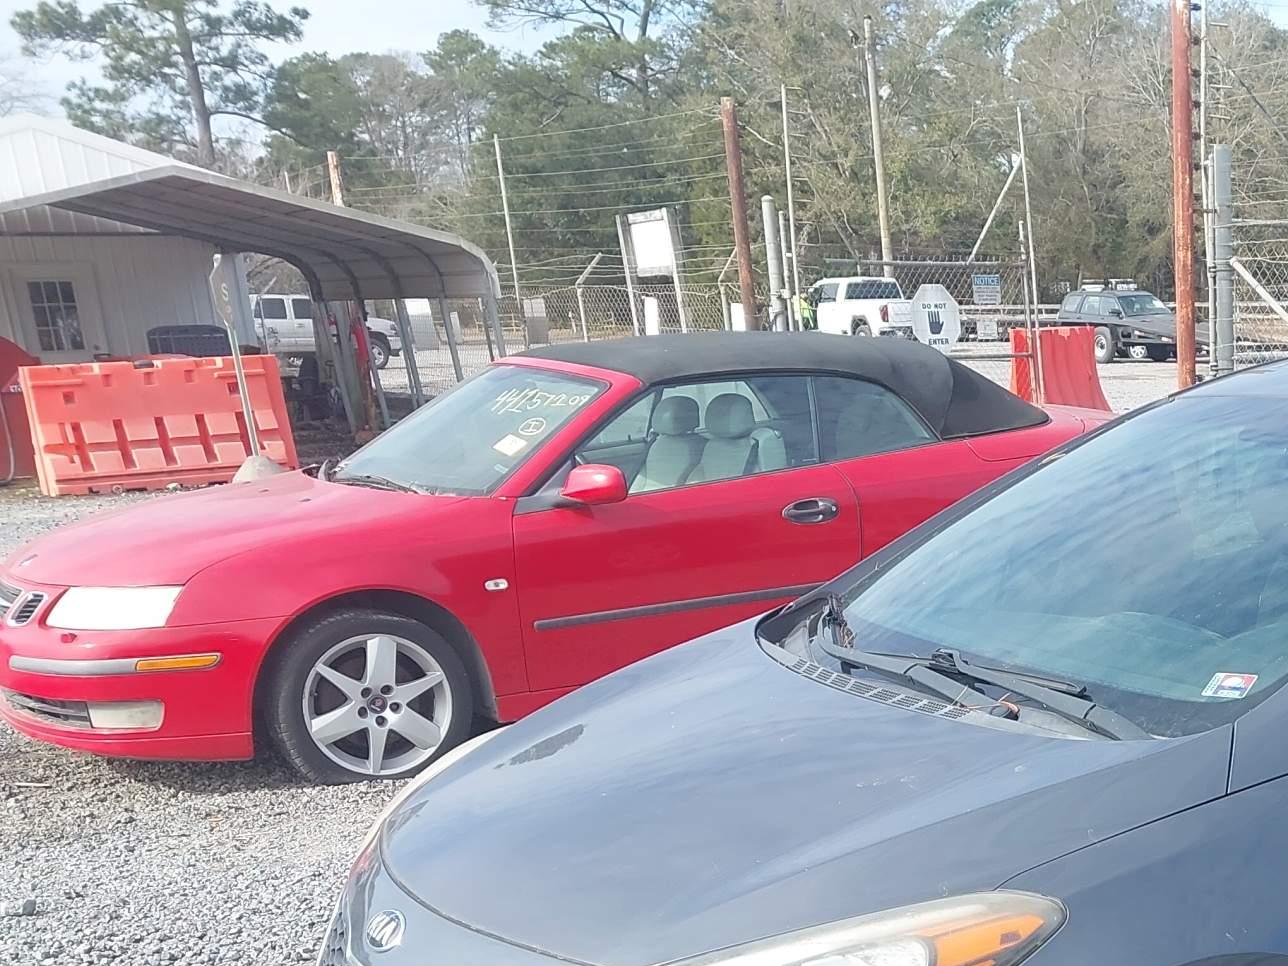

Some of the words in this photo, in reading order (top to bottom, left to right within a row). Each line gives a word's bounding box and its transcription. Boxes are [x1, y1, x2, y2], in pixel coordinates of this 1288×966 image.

[974, 276, 1000, 286] NOTICE
[934, 302, 947, 310] NOT
[928, 338, 950, 346] ENTER
